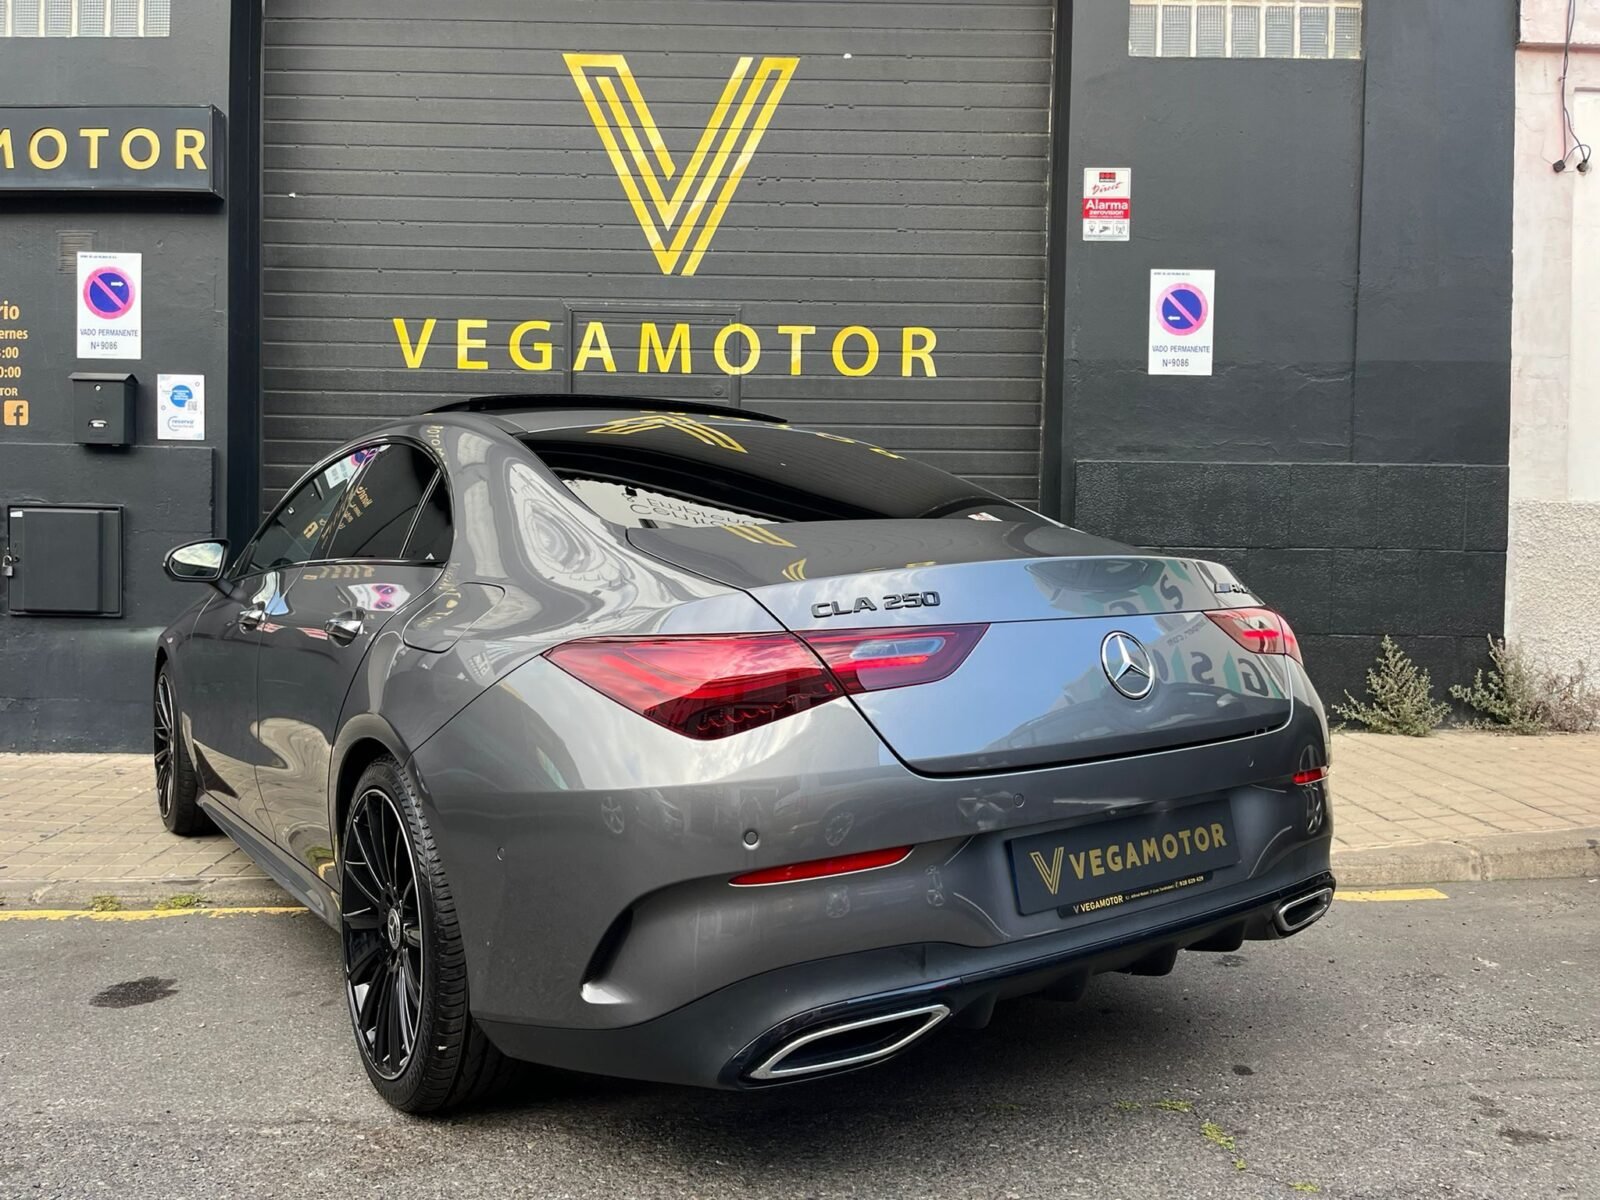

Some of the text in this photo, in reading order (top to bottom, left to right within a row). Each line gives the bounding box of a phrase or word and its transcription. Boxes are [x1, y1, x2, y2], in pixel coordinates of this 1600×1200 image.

[1085, 199, 1129, 210] Alarma
[80, 328, 139, 338] VADO PERMANENTE
[0, 346, 20, 358] :00
[393, 318, 938, 377] VEGAMOTOR
[1152, 345, 1211, 354] VADO PERMANENTE
[811, 591, 941, 618] CLA 250
[1069, 823, 1227, 880] VEGAMOTOR
[1080, 894, 1124, 912] VEGAMOTOR
